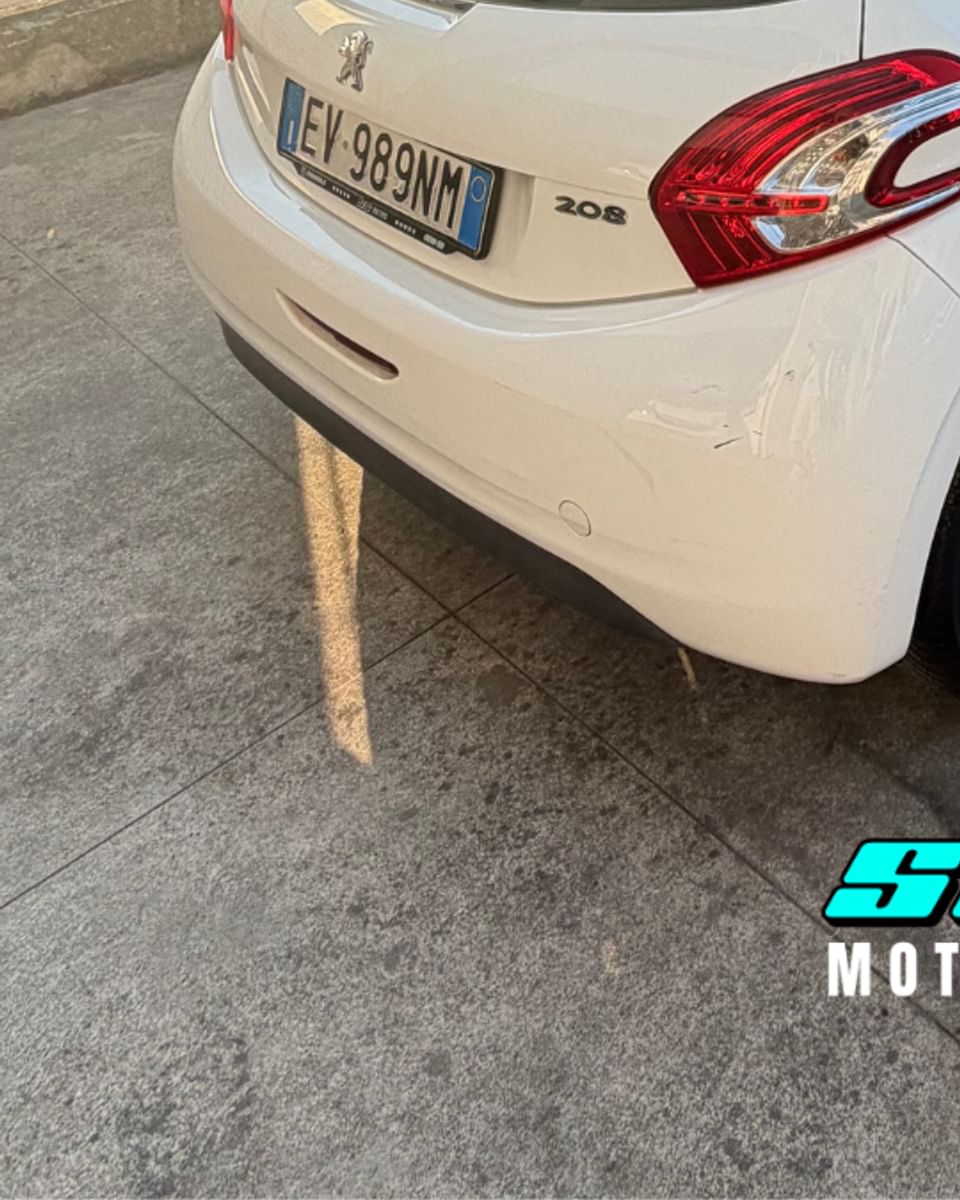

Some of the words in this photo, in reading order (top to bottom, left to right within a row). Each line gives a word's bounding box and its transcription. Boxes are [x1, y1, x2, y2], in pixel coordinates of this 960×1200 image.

[300, 95, 344, 164] EV
[350, 123, 464, 230] 989NM
[554, 195, 627, 225] 208
